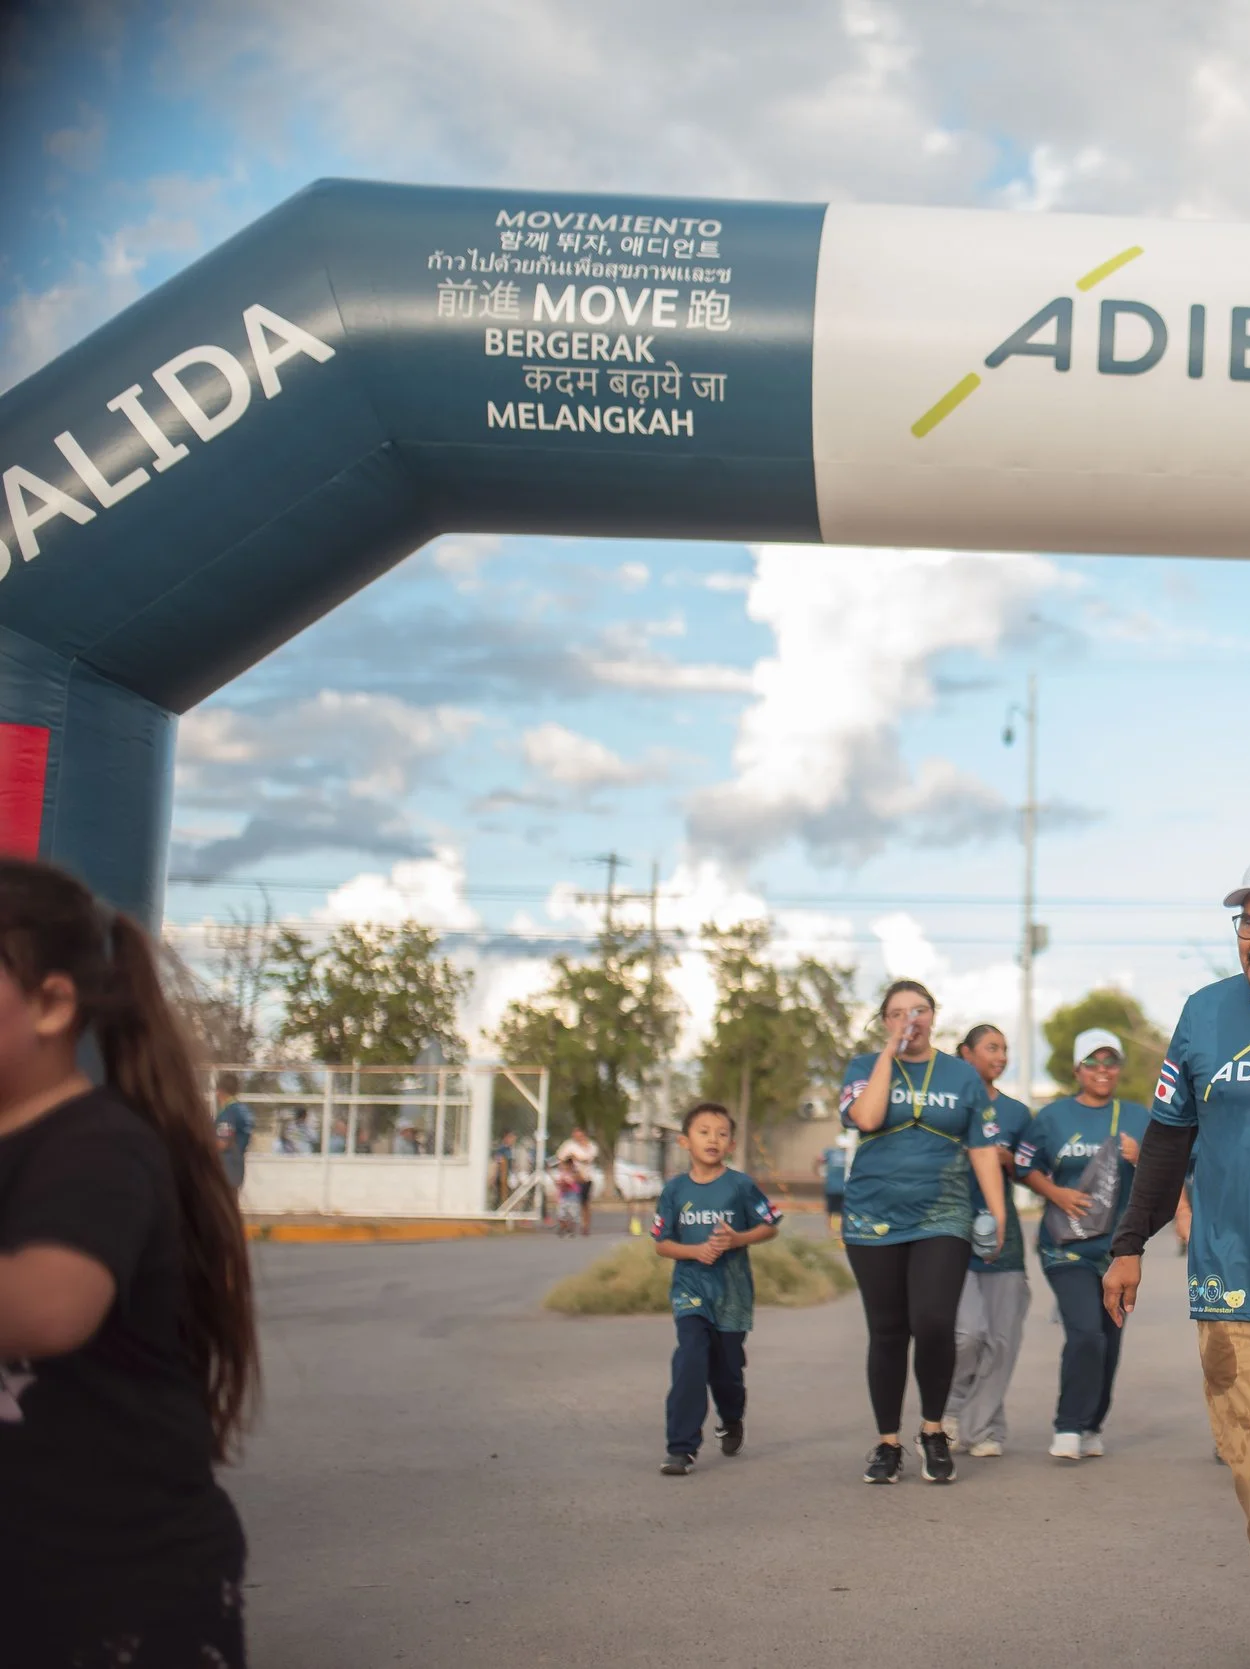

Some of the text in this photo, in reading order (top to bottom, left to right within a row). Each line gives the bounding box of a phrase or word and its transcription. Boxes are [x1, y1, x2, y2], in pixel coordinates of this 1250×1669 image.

[495, 209, 722, 237] MOVIMIENTO
[500, 230, 549, 252] 함께
[620, 235, 721, 259] 애디언트
[437, 278, 732, 331] 前進 MOVE 跑
[484, 327, 656, 363] BERGERAK
[522, 365, 599, 398] कदम
[690, 373, 727, 402] जा
[487, 400, 695, 437] MELANGKAH
[0, 303, 336, 582] ALIDA
[891, 1087, 959, 1110] DIENT
